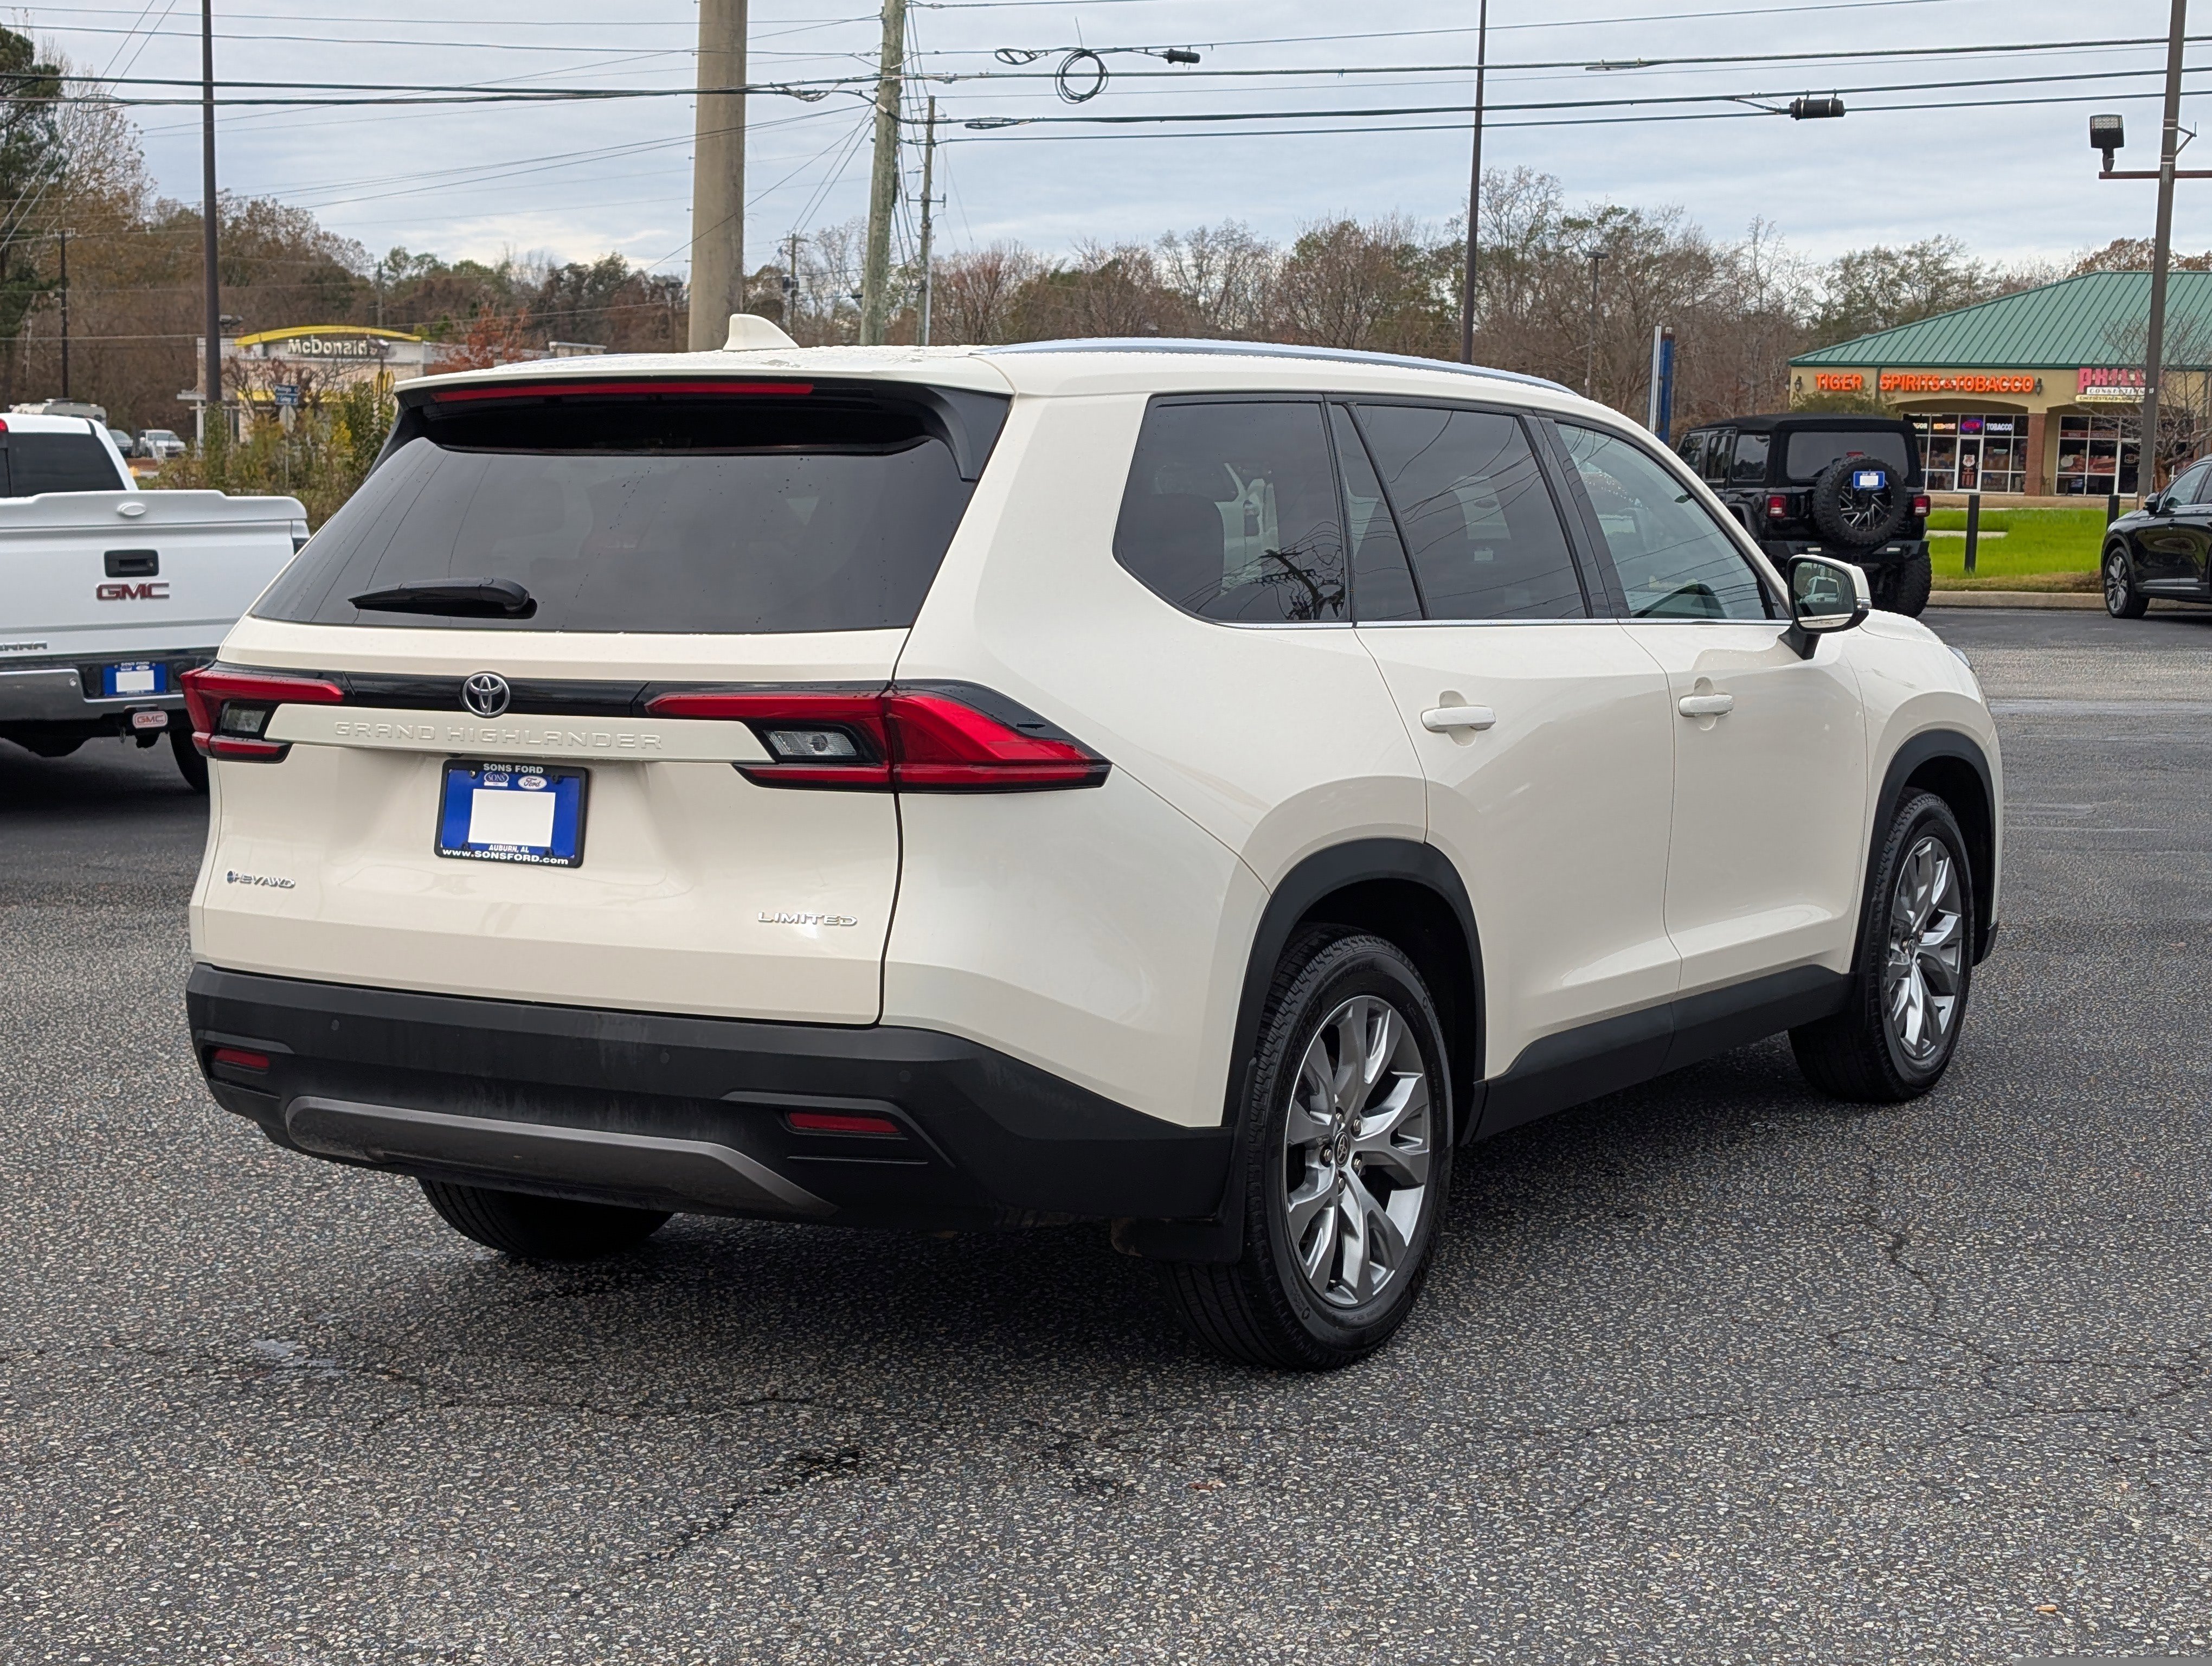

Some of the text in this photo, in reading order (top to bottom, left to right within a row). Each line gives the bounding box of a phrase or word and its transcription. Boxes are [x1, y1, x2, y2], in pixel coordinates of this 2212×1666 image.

[287, 338, 378, 356] McDonalds
[1816, 373, 2035, 393] TIGER SPIRITS & TOBACCO
[2078, 368, 2163, 393] PHILL
[1986, 423, 2013, 431] TOBACCO
[96, 582, 170, 600] GMC
[137, 715, 164, 723] GMC
[335, 721, 663, 749] GRAND HIGHLANDER
[483, 763, 544, 774] SONS FORD
[524, 777, 542, 787] Ford
[488, 844, 529, 853] AUBURN, AL
[442, 849, 569, 865] www.SONSFORD.com
[758, 912, 858, 926] LIMITED
